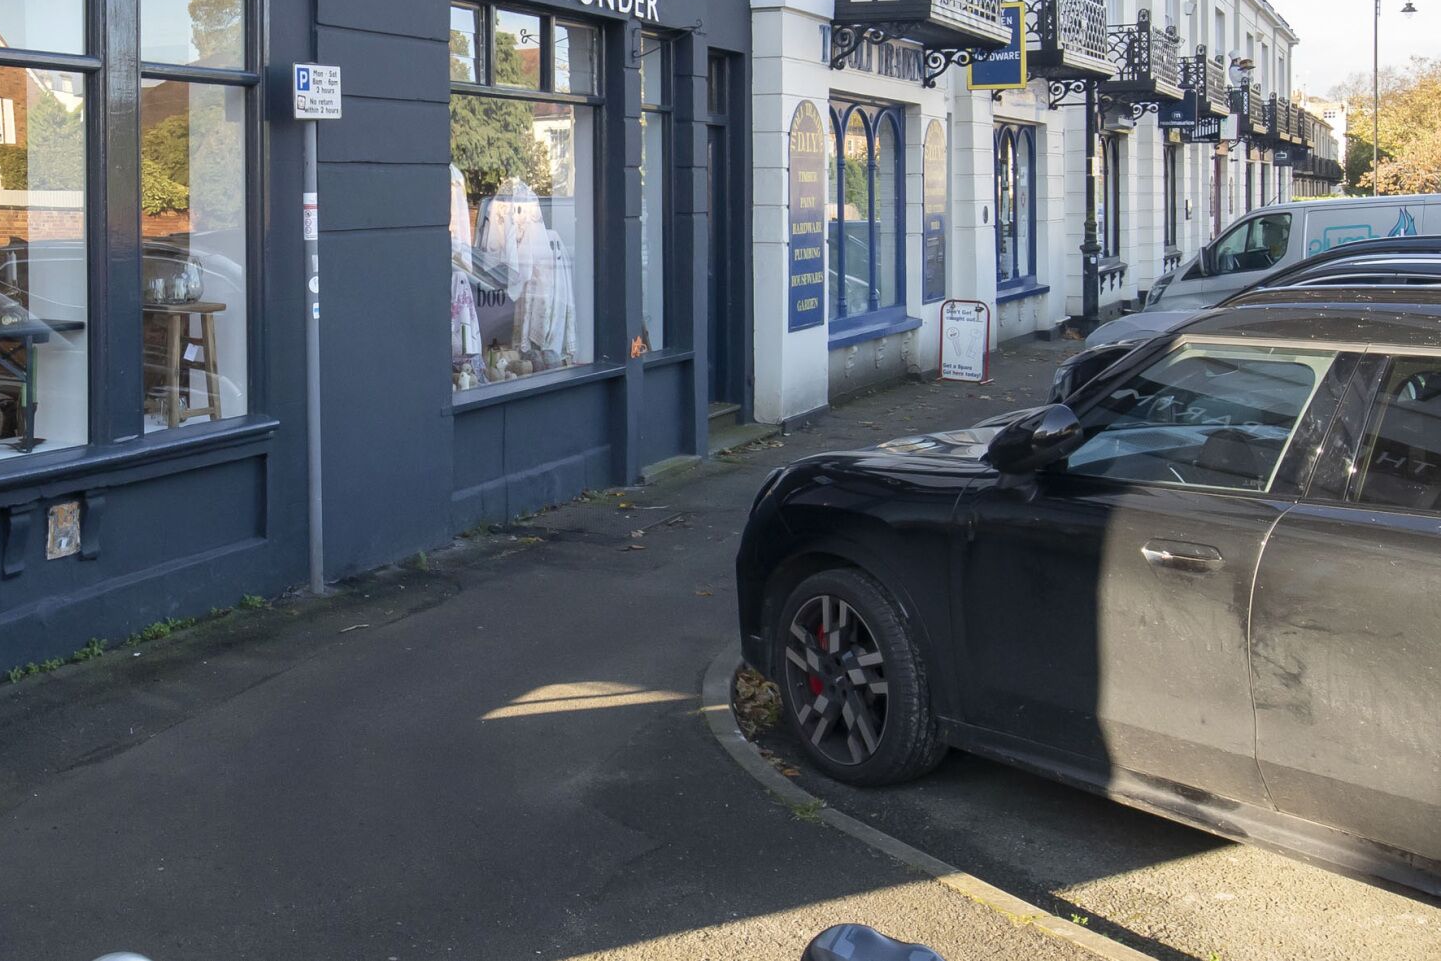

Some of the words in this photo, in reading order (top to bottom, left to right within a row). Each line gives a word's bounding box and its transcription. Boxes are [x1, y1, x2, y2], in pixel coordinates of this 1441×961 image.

[300, 70, 308, 89] P
[800, 197, 816, 208] PAINT
[792, 222, 823, 234] HARDWARE
[794, 247, 820, 260] PLUMBING
[791, 271, 824, 287] HOUSEWARES
[477, 282, 506, 307] boo
[797, 297, 819, 311] GARDEN
